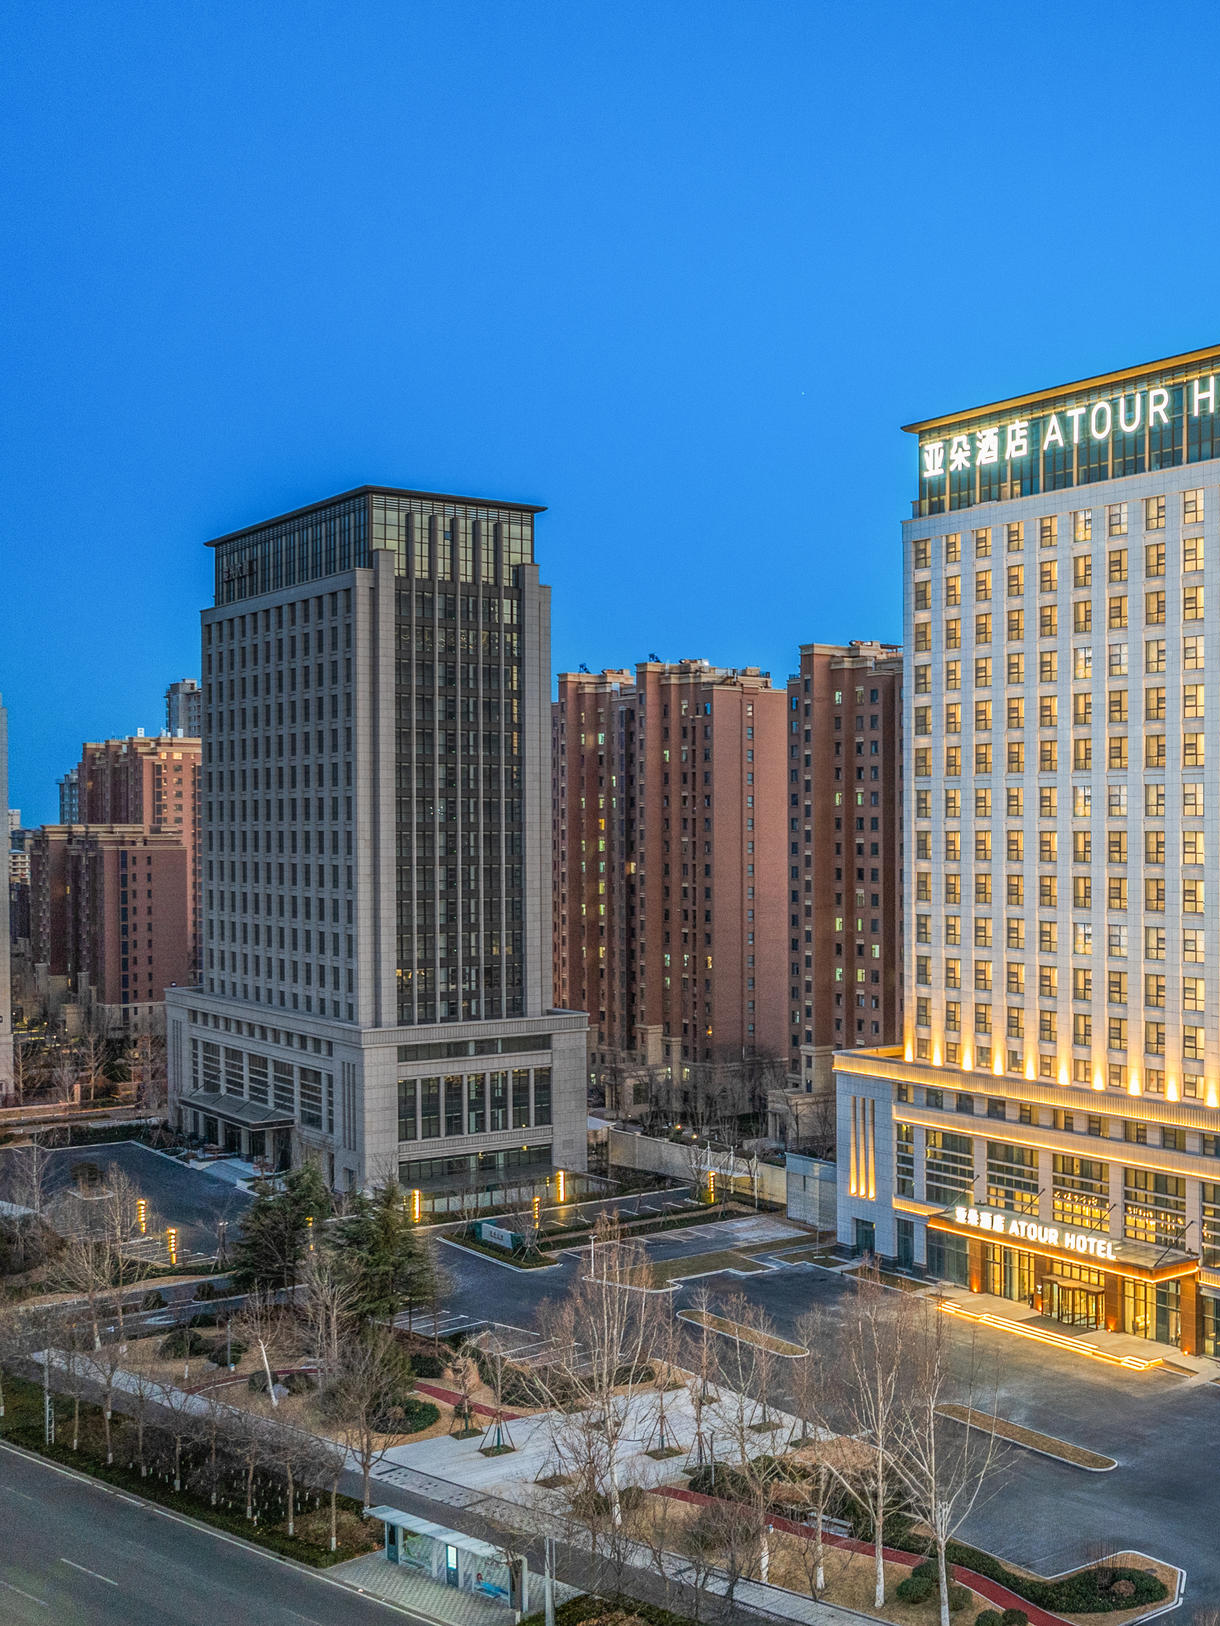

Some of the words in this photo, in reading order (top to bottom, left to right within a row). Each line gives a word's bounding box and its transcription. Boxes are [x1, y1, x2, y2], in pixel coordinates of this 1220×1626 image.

[923, 420, 1029, 478] 亚朵酒店
[1043, 388, 1169, 450] ATOUR
[1009, 1220, 1059, 1246] ATOUR
[1064, 1233, 1117, 1260] HOTEL
